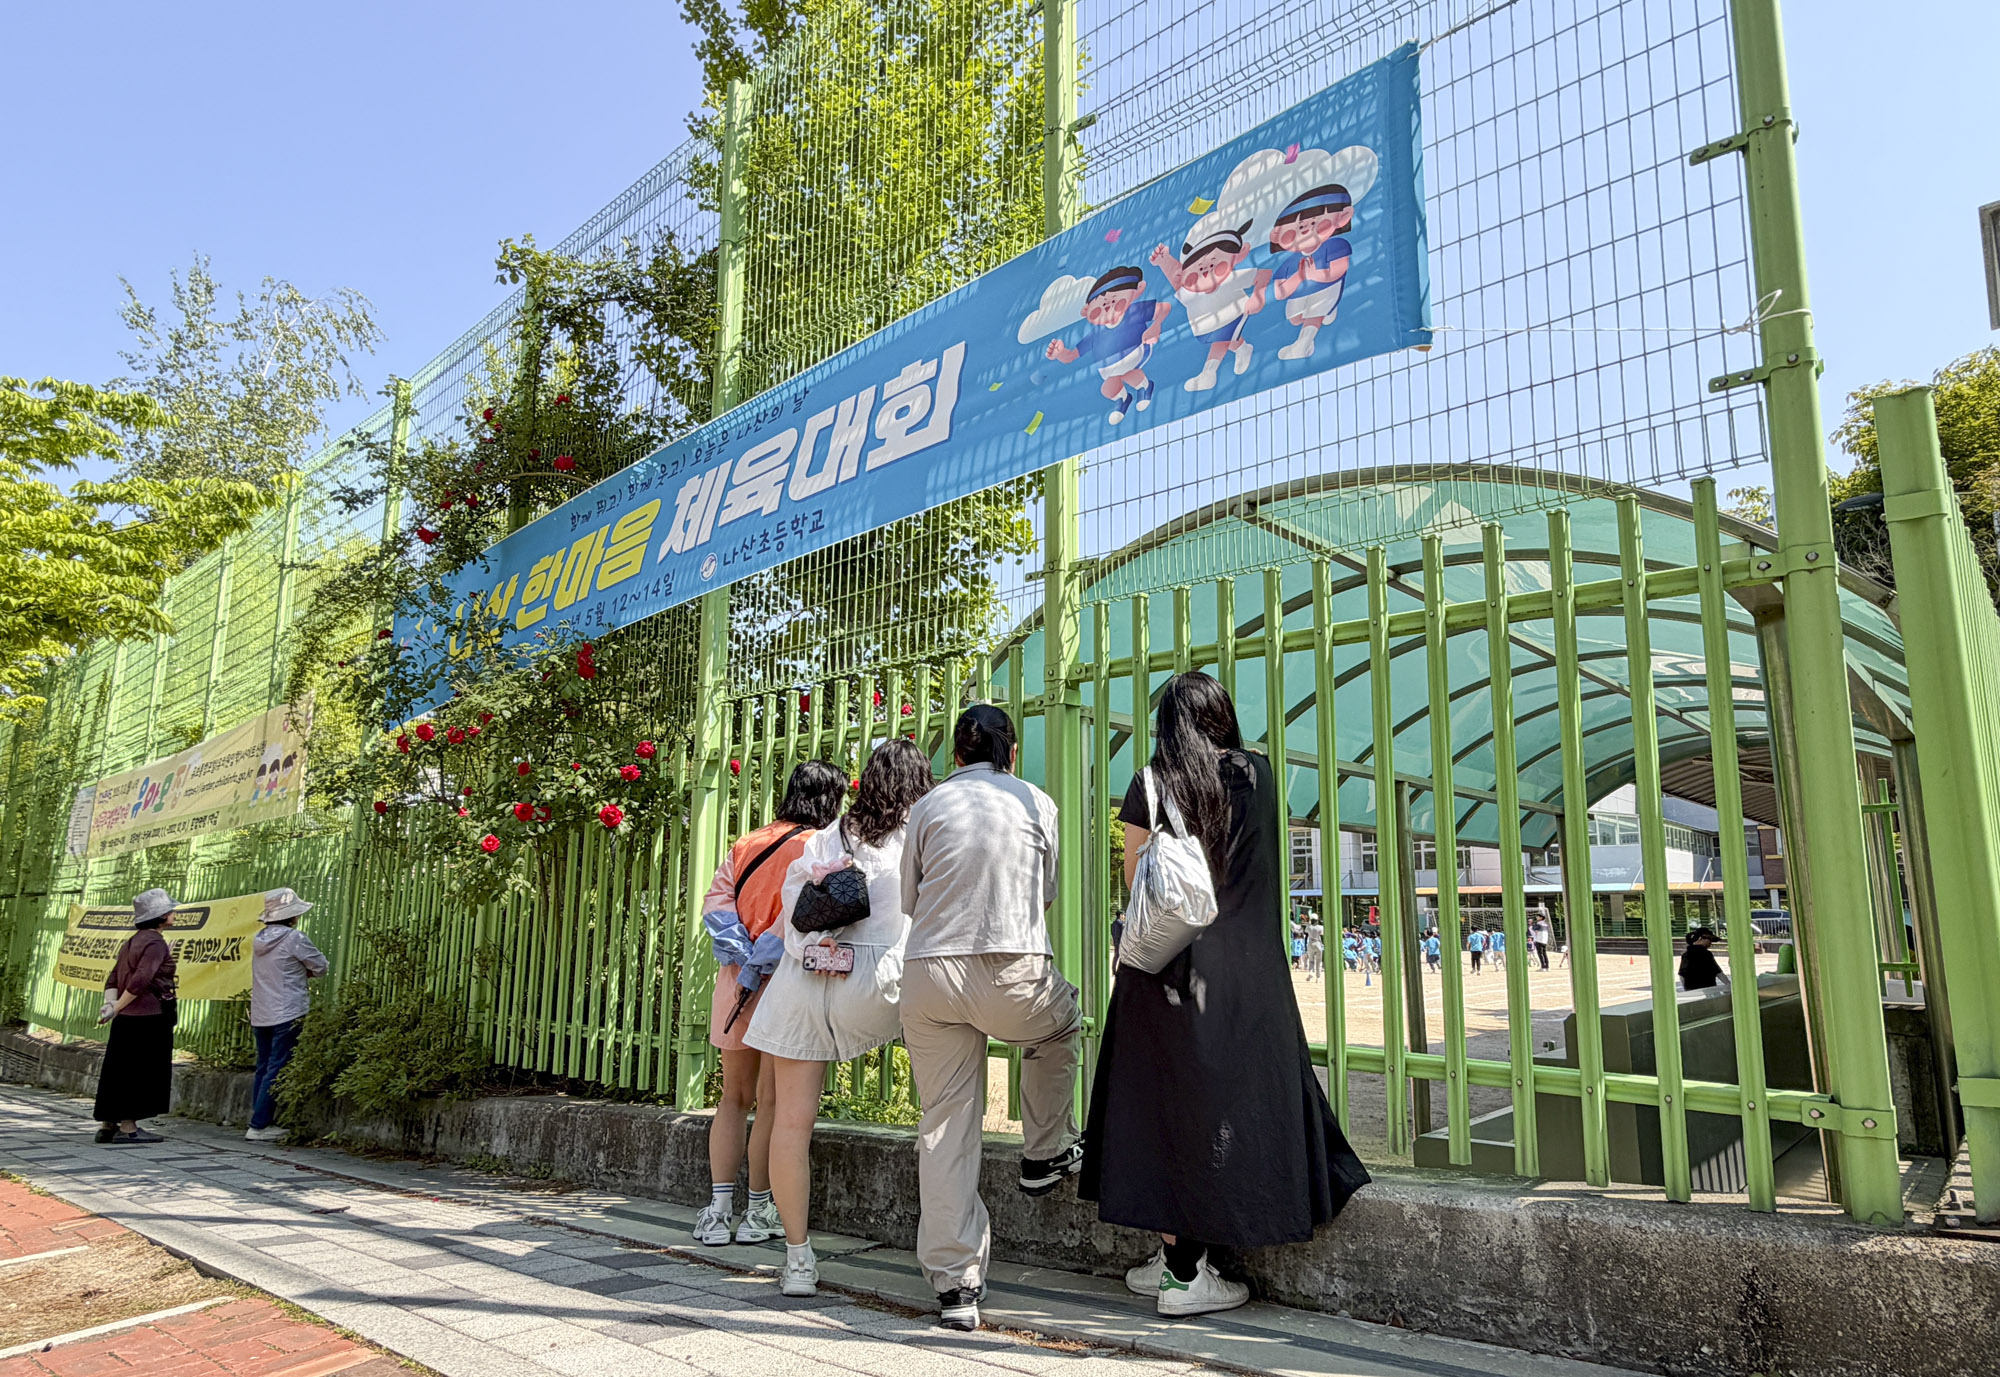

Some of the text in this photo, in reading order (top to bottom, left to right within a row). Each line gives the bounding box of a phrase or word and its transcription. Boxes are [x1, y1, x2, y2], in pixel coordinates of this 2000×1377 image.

[515, 498, 661, 631] 한마음
[657, 340, 967, 564] 체육대회
[571, 386, 810, 533] 함께 뛰고! 함께 웃고! 오늘은 나산의 날
[722, 509, 825, 567] 나산초등학교
[585, 568, 676, 627] 5월 12~14일
[183, 936, 246, 964] 축하합니다!
